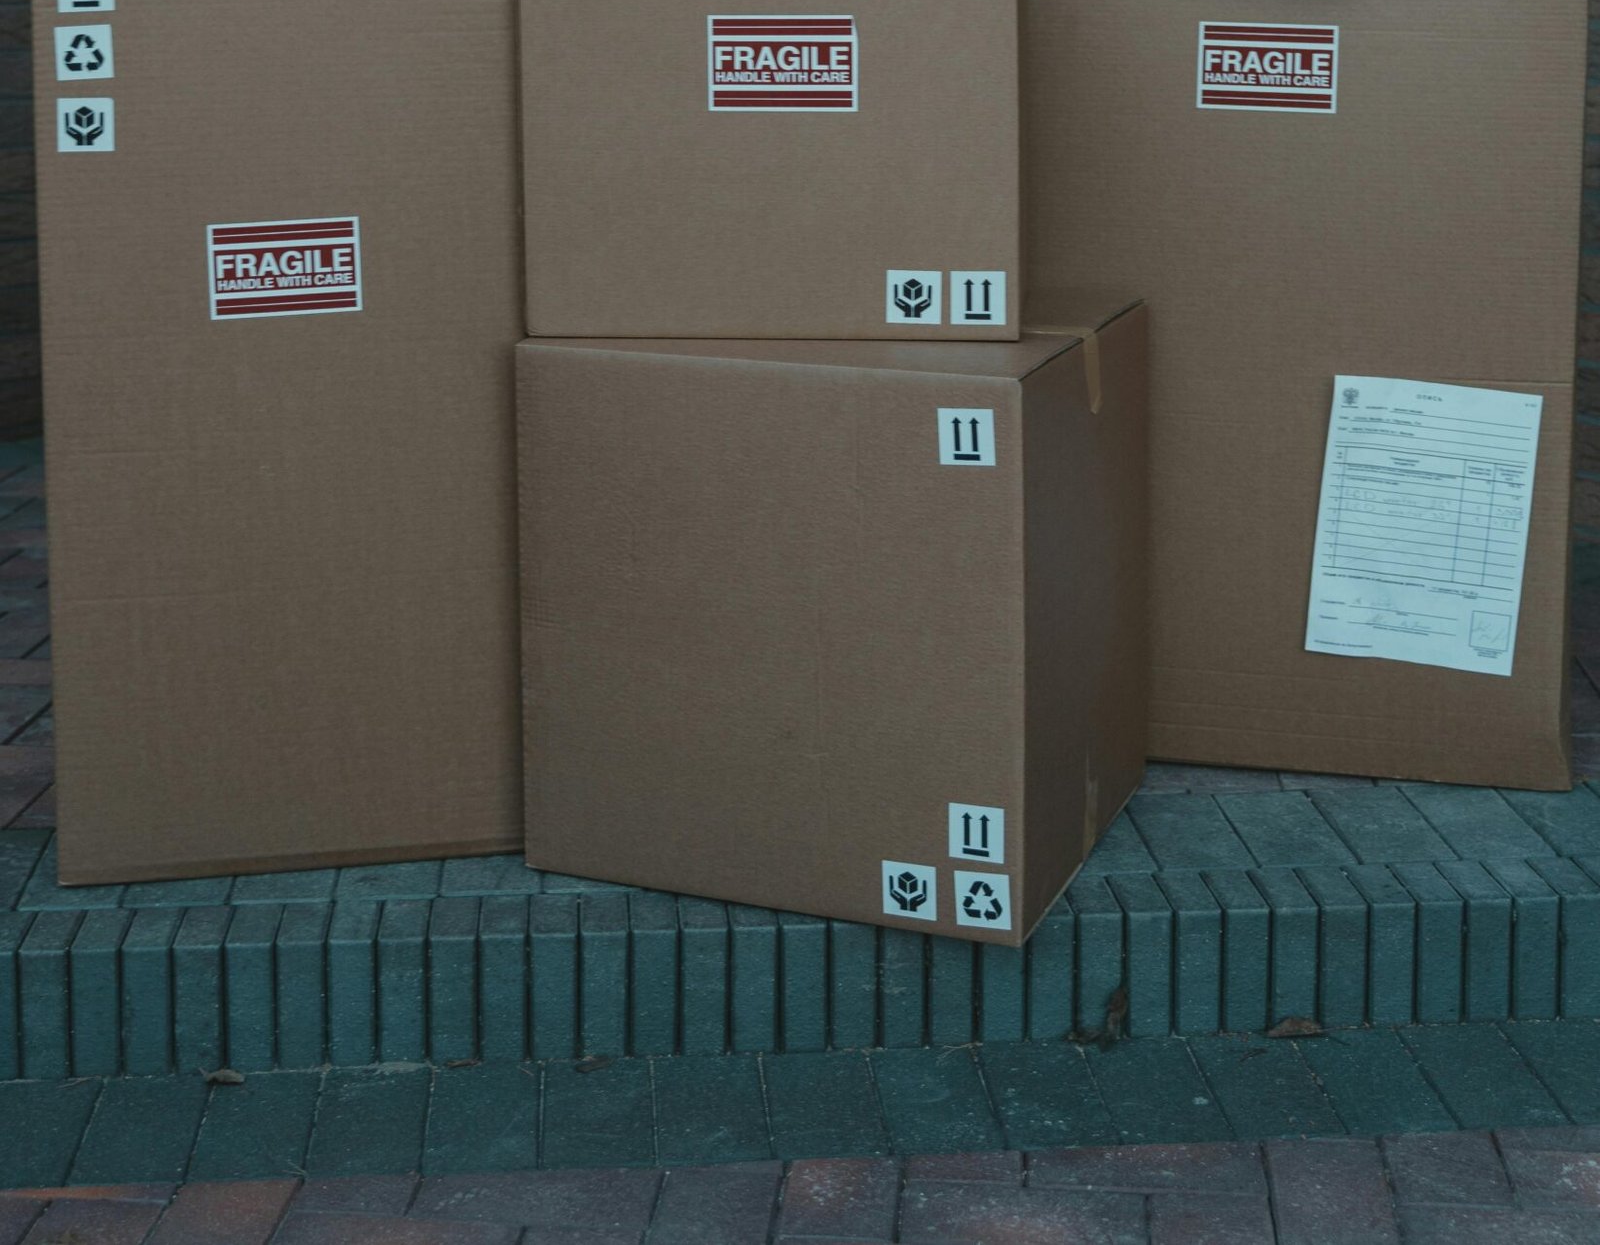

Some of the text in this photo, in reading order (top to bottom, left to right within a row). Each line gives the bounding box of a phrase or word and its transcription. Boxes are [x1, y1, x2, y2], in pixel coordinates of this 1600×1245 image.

[714, 46, 850, 70] FRAGILE
[1204, 49, 1330, 75] FRAGILE
[715, 71, 850, 83] HANDLE WITH CARE
[1204, 72, 1330, 87] HANDLE WITH CARE
[215, 248, 353, 278] FRAGILE
[217, 272, 353, 291] HANDLE WITH CARE
